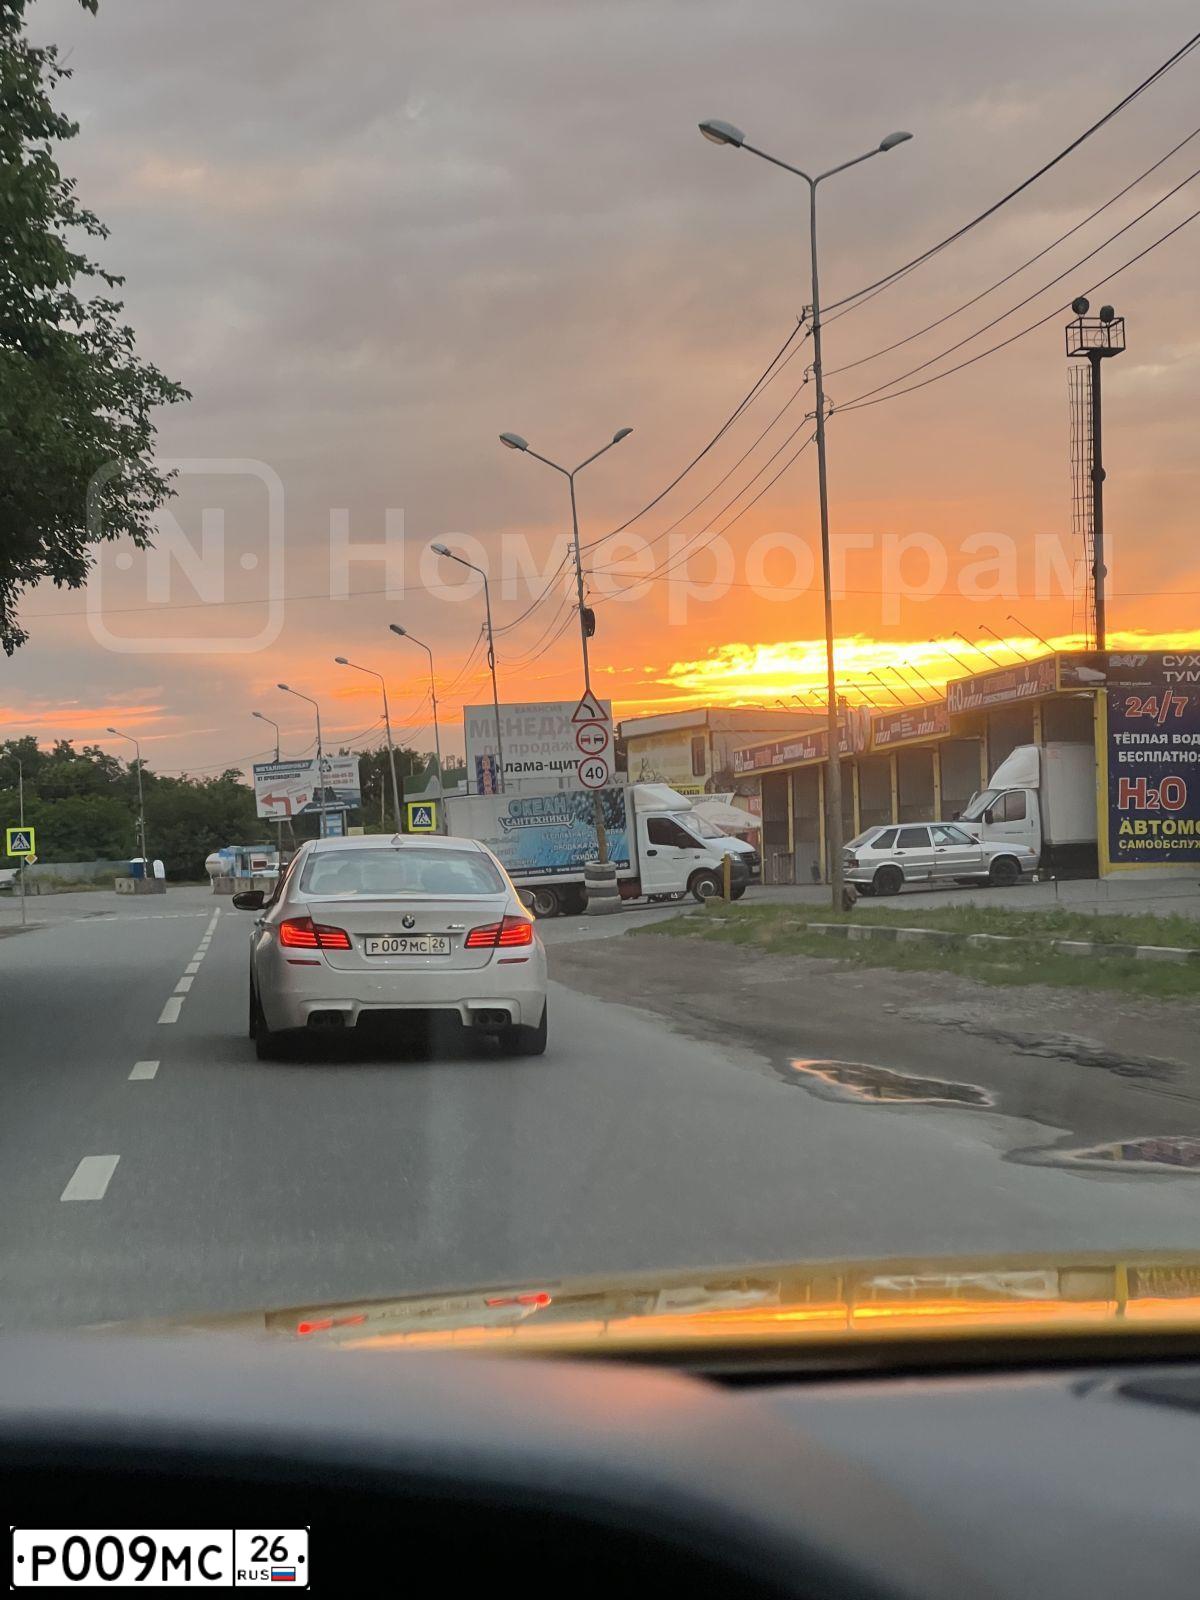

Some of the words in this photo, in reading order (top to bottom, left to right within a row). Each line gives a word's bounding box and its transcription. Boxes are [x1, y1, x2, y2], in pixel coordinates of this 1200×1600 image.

[1125, 690, 1189, 723] 24/7
[470, 715, 578, 739] МЕНЕДЖ
[1113, 732, 1168, 745] ТЁПЛАЯ
[585, 766, 604, 780] 40
[1118, 775, 1187, 811] H2O
[508, 797, 567, 817] ОКЕАН
[505, 814, 571, 826] САНТЕХНИКИ
[370, 939, 428, 953] Р009МС
[431, 938, 446, 949] 26
